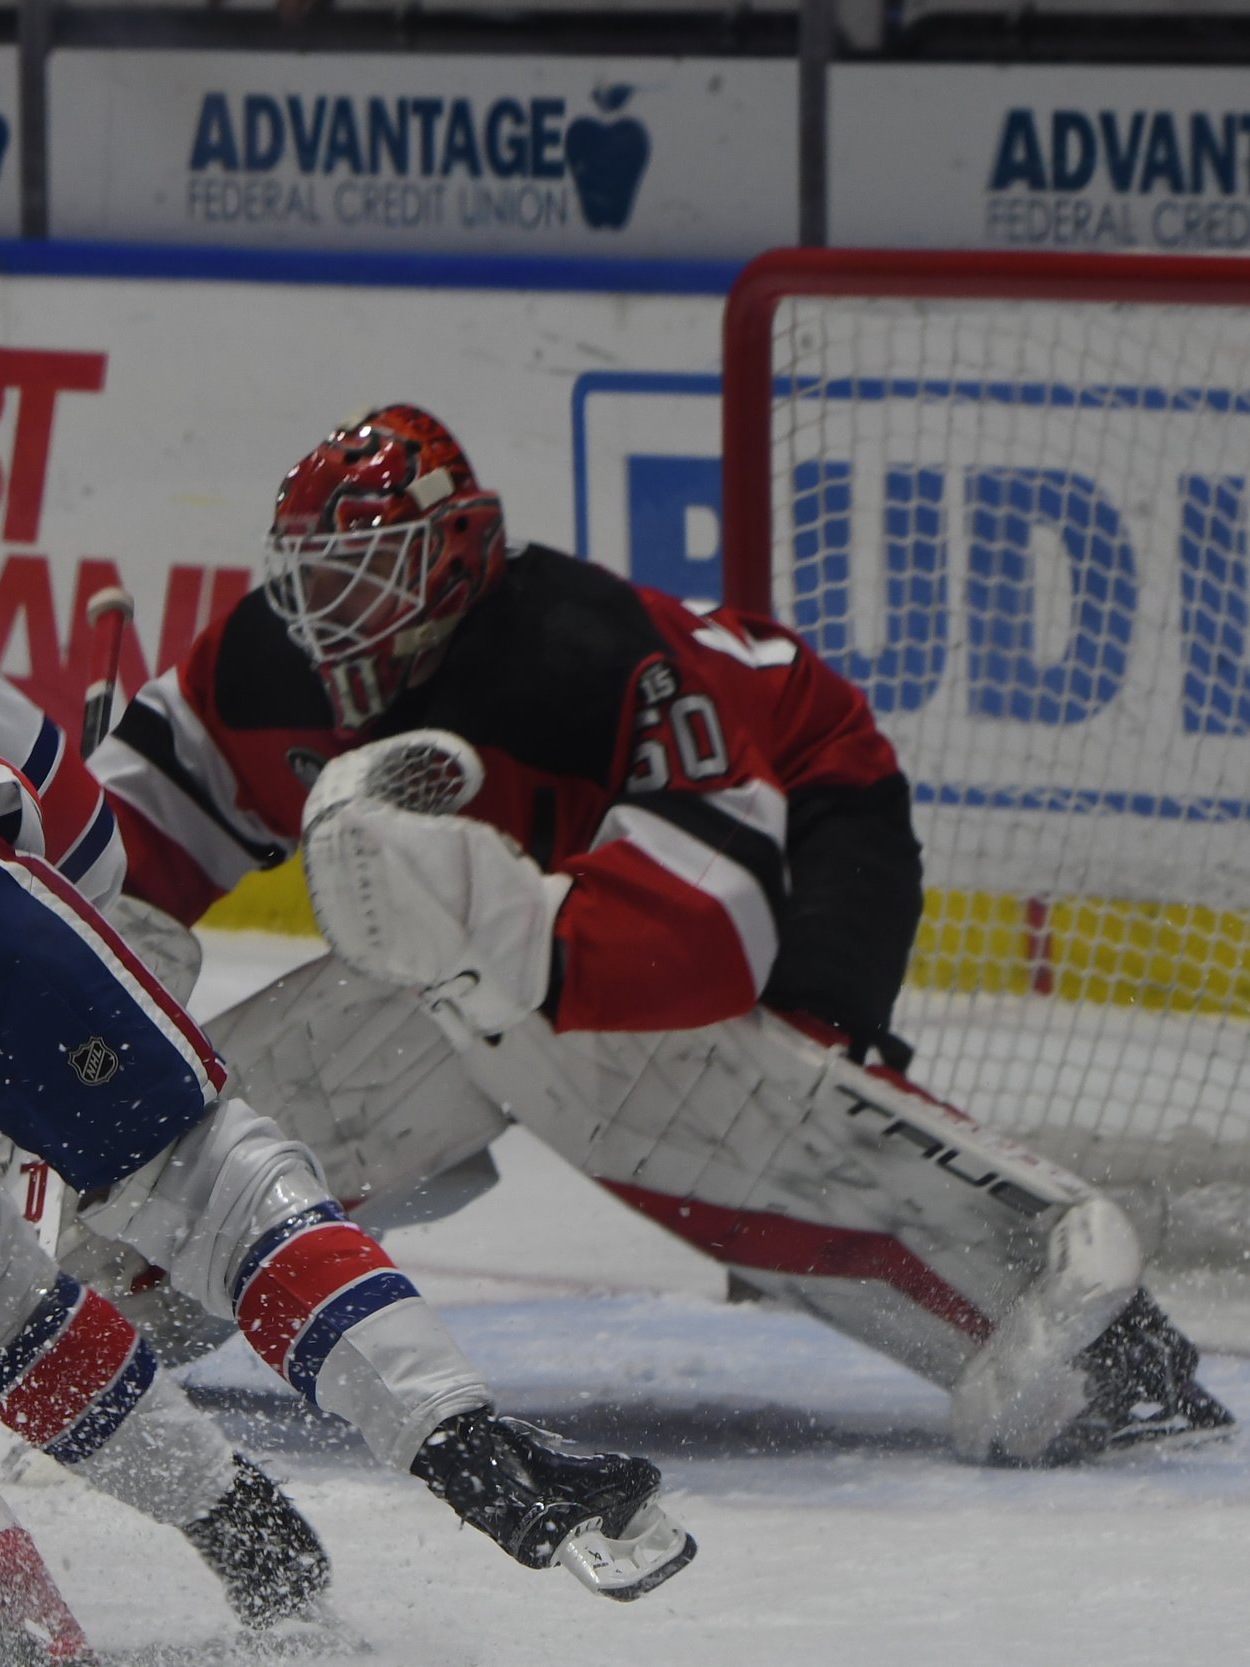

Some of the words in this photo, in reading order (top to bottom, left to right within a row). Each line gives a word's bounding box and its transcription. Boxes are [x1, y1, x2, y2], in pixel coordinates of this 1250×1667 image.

[188, 92, 566, 179] ADVANTAGE
[186, 180, 319, 223] FEDERAL
[332, 181, 446, 228] CREDIT
[459, 183, 569, 230] UNION
[986, 198, 1138, 246] FEDERAL
